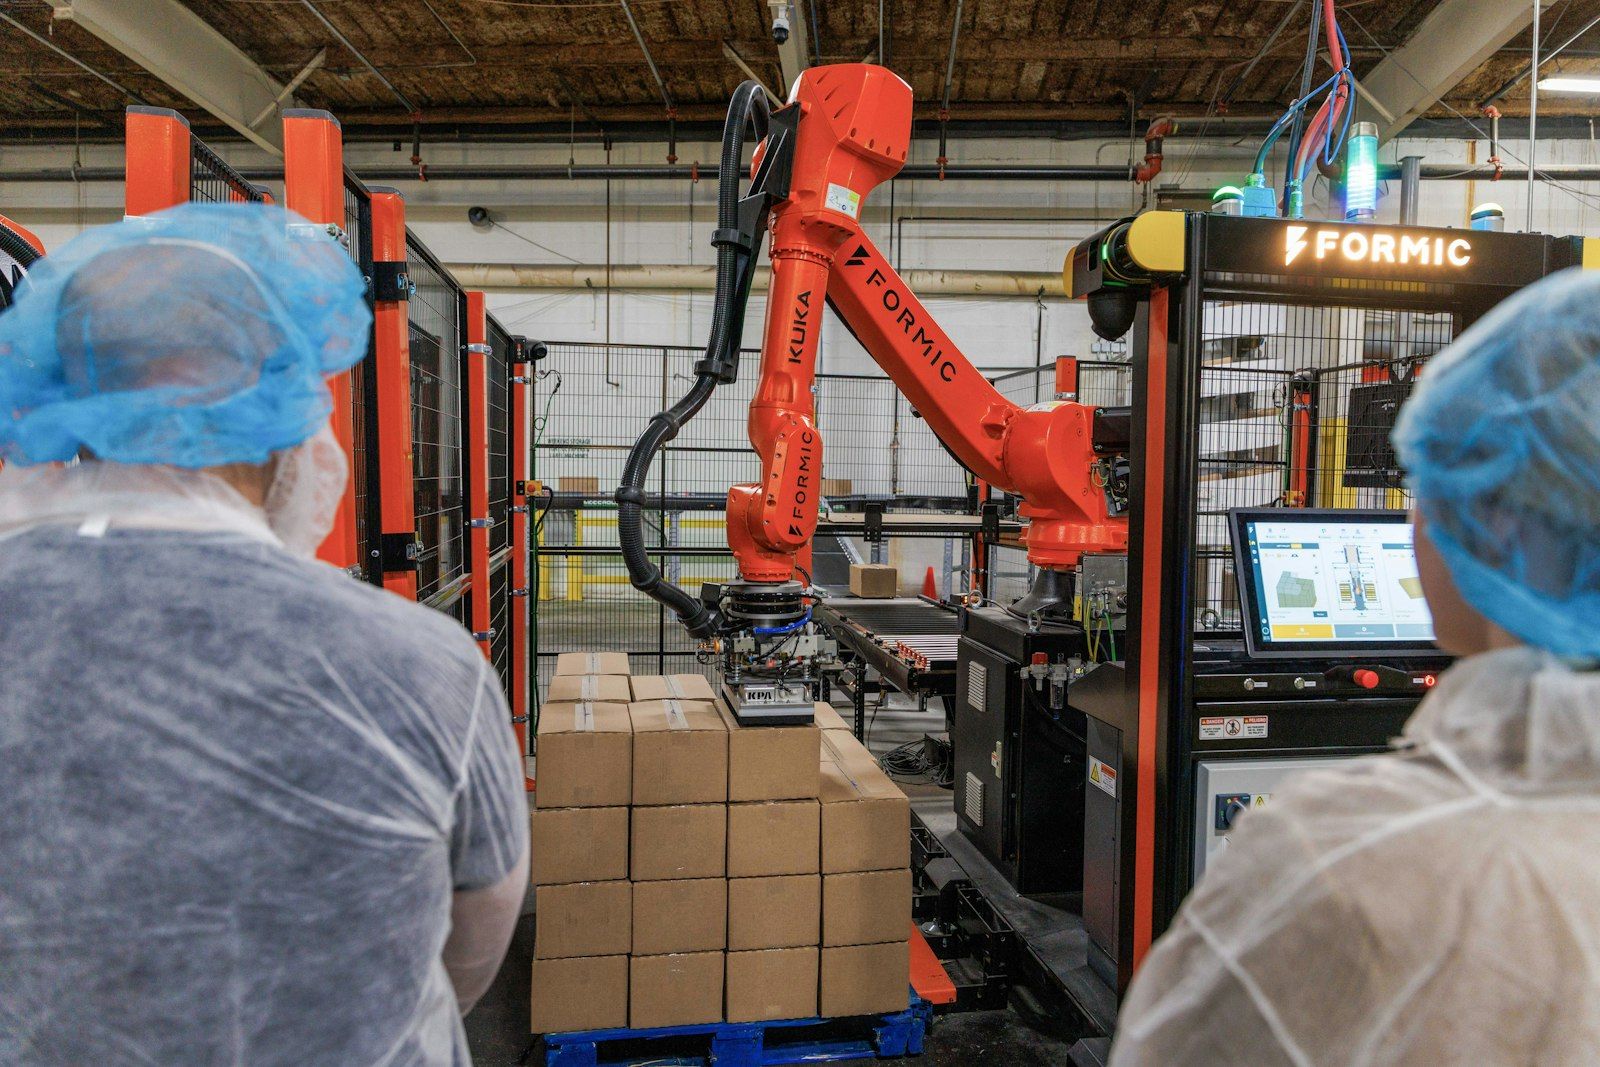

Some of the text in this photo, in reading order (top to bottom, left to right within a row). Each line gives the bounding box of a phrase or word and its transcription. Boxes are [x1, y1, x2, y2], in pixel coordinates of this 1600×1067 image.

[1316, 230, 1472, 267] FORMIC
[788, 290, 812, 365] KUKA
[866, 268, 957, 383] FORMIC
[793, 431, 813, 519] FORMIC
[748, 691, 772, 700] KPA
